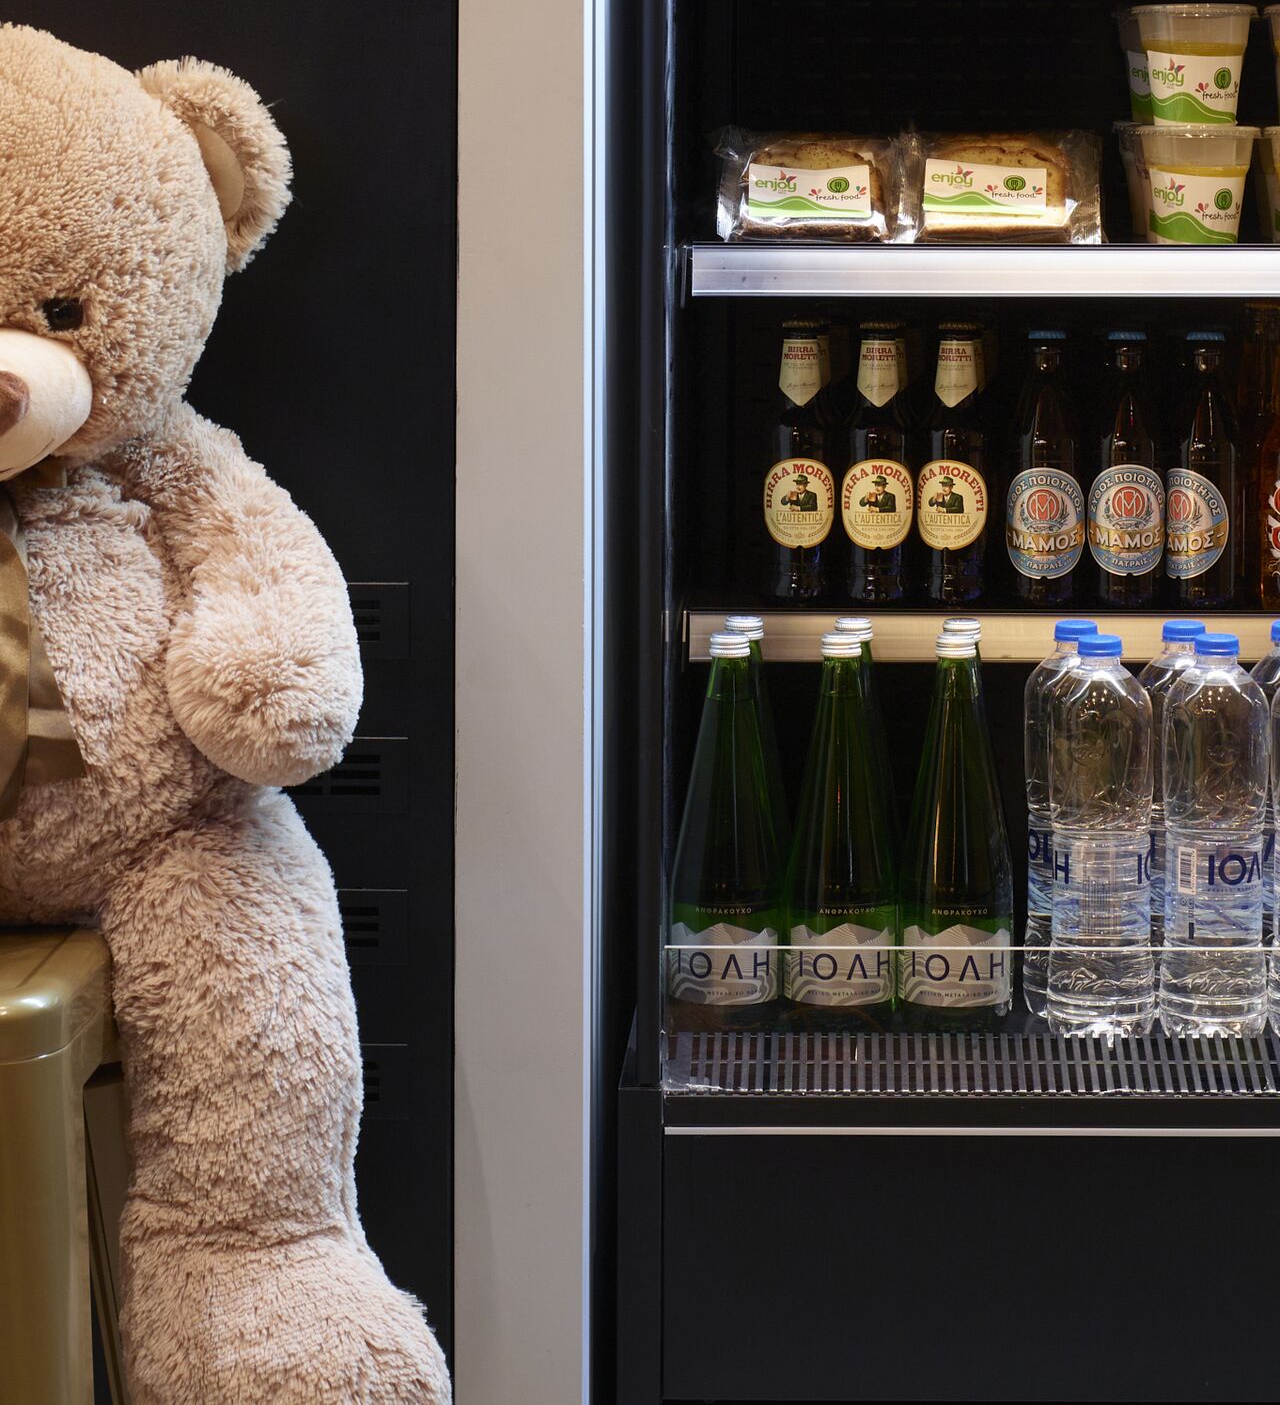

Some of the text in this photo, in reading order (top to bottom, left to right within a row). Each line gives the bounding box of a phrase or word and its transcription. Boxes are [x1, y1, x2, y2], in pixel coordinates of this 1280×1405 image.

[1151, 67, 1186, 87] enjoy
[755, 176, 797, 194] enjoy
[931, 170, 974, 188] enjoy
[815, 193, 862, 202] fresh food
[766, 463, 833, 509] BIRRA MORETTI
[843, 464, 911, 510] BIRRA MORETTI
[918, 465, 984, 512] BIRRA MORETTI
